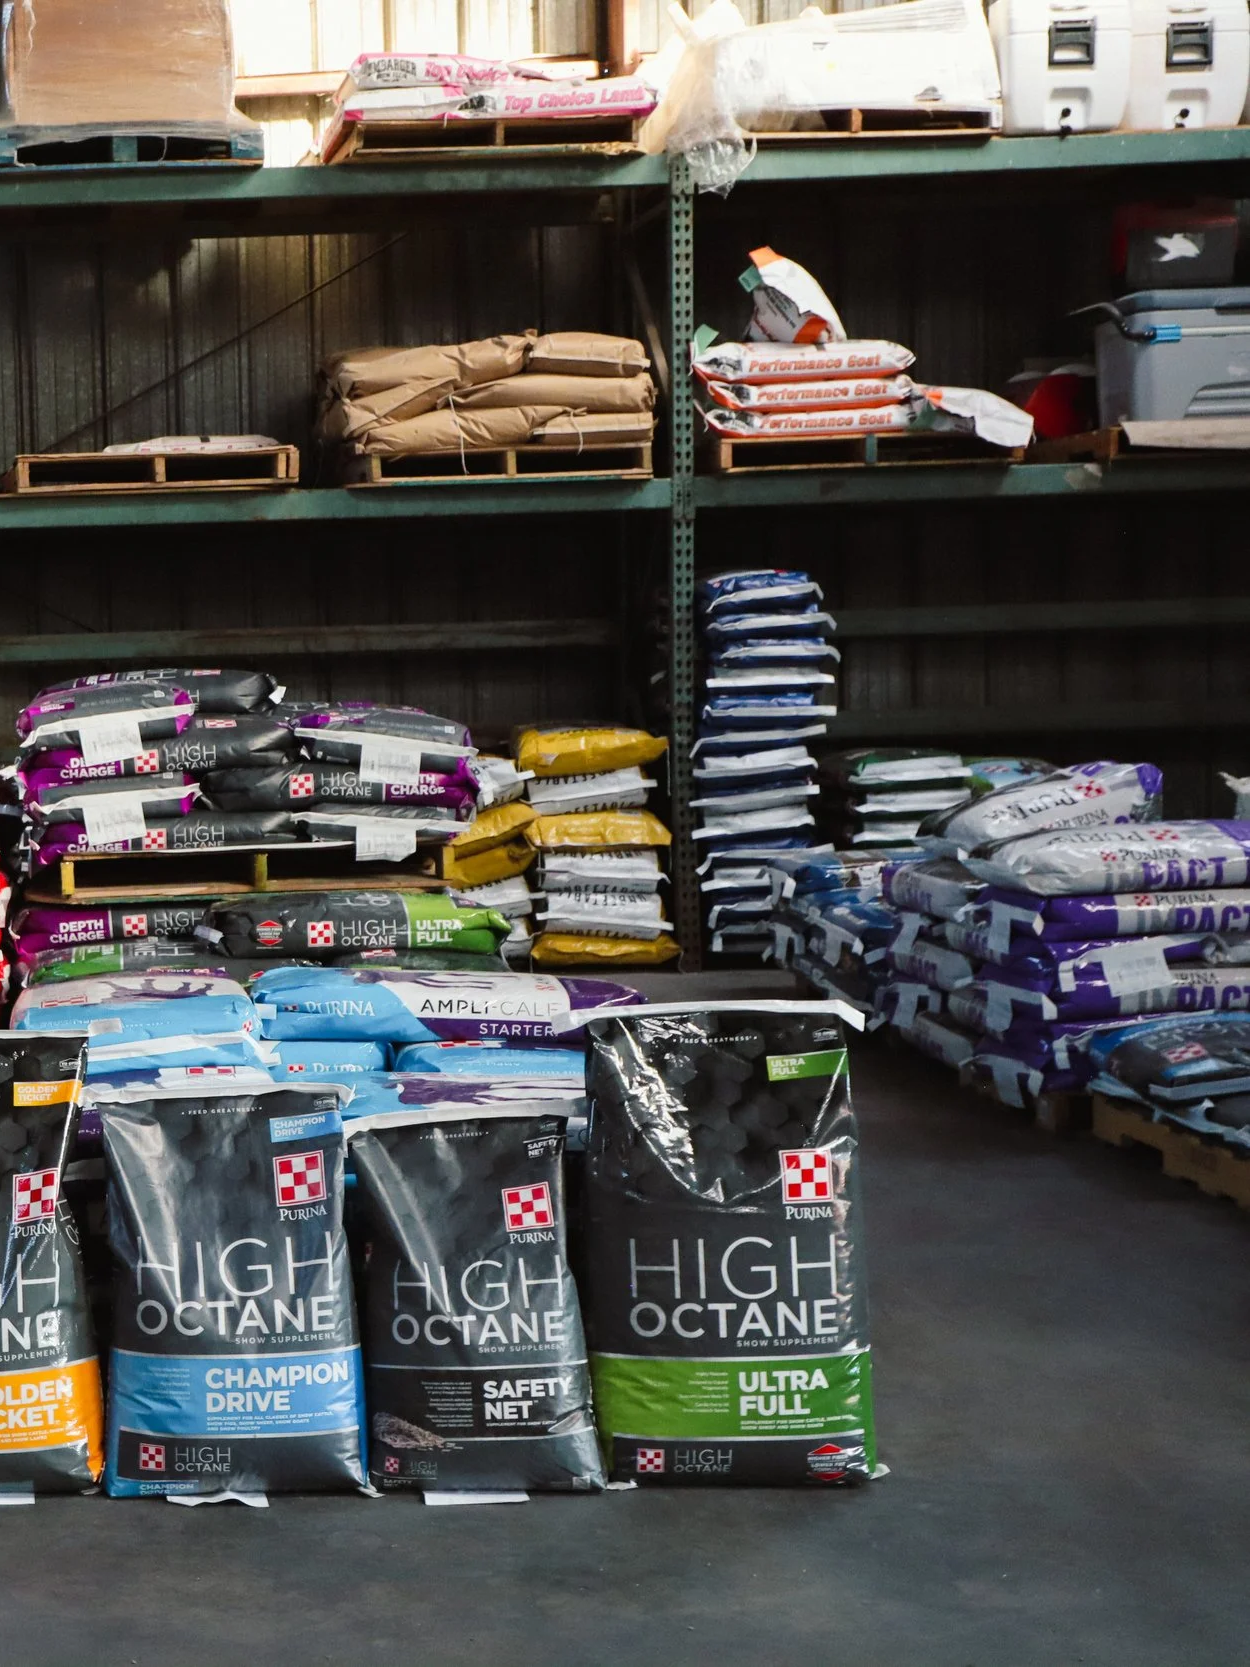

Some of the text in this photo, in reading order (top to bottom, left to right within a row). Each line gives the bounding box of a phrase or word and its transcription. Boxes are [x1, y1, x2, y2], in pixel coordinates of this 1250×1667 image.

[425, 62, 451, 81] Top
[505, 86, 646, 113] Top Choice Lamb
[749, 354, 882, 372] Performance Goat
[757, 382, 888, 401] Performance Goat
[760, 411, 893, 430] Performance Goat
[165, 745, 217, 762] HIGH
[60, 765, 116, 779] CHARGE
[166, 760, 217, 771] OCTANE
[320, 786, 372, 797] OCTANE
[390, 785, 446, 796] CHARGE
[174, 825, 225, 842] HIGH
[67, 842, 125, 852] CHARGE
[1154, 893, 1218, 907] PURINA
[59, 919, 105, 933] DEPTH
[154, 912, 203, 927] HIGH
[415, 919, 462, 931] ULTRA
[341, 919, 397, 937] HIGH
[50, 930, 105, 944] CHARGE
[341, 935, 397, 946] OCTANE
[415, 931, 454, 943] FULL
[305, 998, 560, 1019] PURINA AMPLI-CALF
[479, 1022, 556, 1037] STARTER
[770, 1058, 806, 1068] ULTRA
[772, 1067, 799, 1075] FULL
[17, 1085, 59, 1094] GOLDEN
[17, 1093, 53, 1101] TICKET
[187, 1106, 256, 1116] FEED GREATNESS
[273, 1115, 326, 1129] CHAMPION
[274, 1127, 304, 1138] DRIVE
[527, 1138, 558, 1150] SAFETY
[528, 1148, 545, 1157] NET
[279, 1204, 328, 1222] PURINA
[785, 1206, 834, 1221] PURINA
[13, 1222, 58, 1240] PURINA
[509, 1231, 556, 1245] PURINA
[136, 1231, 336, 1298] HIGH
[629, 1233, 839, 1300] HIGH
[393, 1254, 564, 1313] HIGH
[136, 1295, 336, 1337] OCTANE
[629, 1299, 840, 1339] OCTANE
[392, 1310, 565, 1347] OCTANE
[235, 1332, 337, 1345] SHOW SUPPLEMENT
[736, 1336, 840, 1347] SHOW SUPPLEMENT
[478, 1346, 506, 1354] SHOW
[205, 1360, 349, 1390] CHAMPION
[738, 1368, 830, 1393] ULTRA
[483, 1376, 572, 1401] SAFETY
[206, 1389, 291, 1414] DRIVE
[739, 1394, 811, 1416] FULL
[484, 1400, 533, 1421] NET
[174, 1446, 231, 1463] HIGH
[674, 1449, 733, 1465] HIGH
[174, 1462, 231, 1473] OCTANE
[673, 1464, 732, 1473] OCTANE
[139, 1483, 195, 1491] CHAMPION
